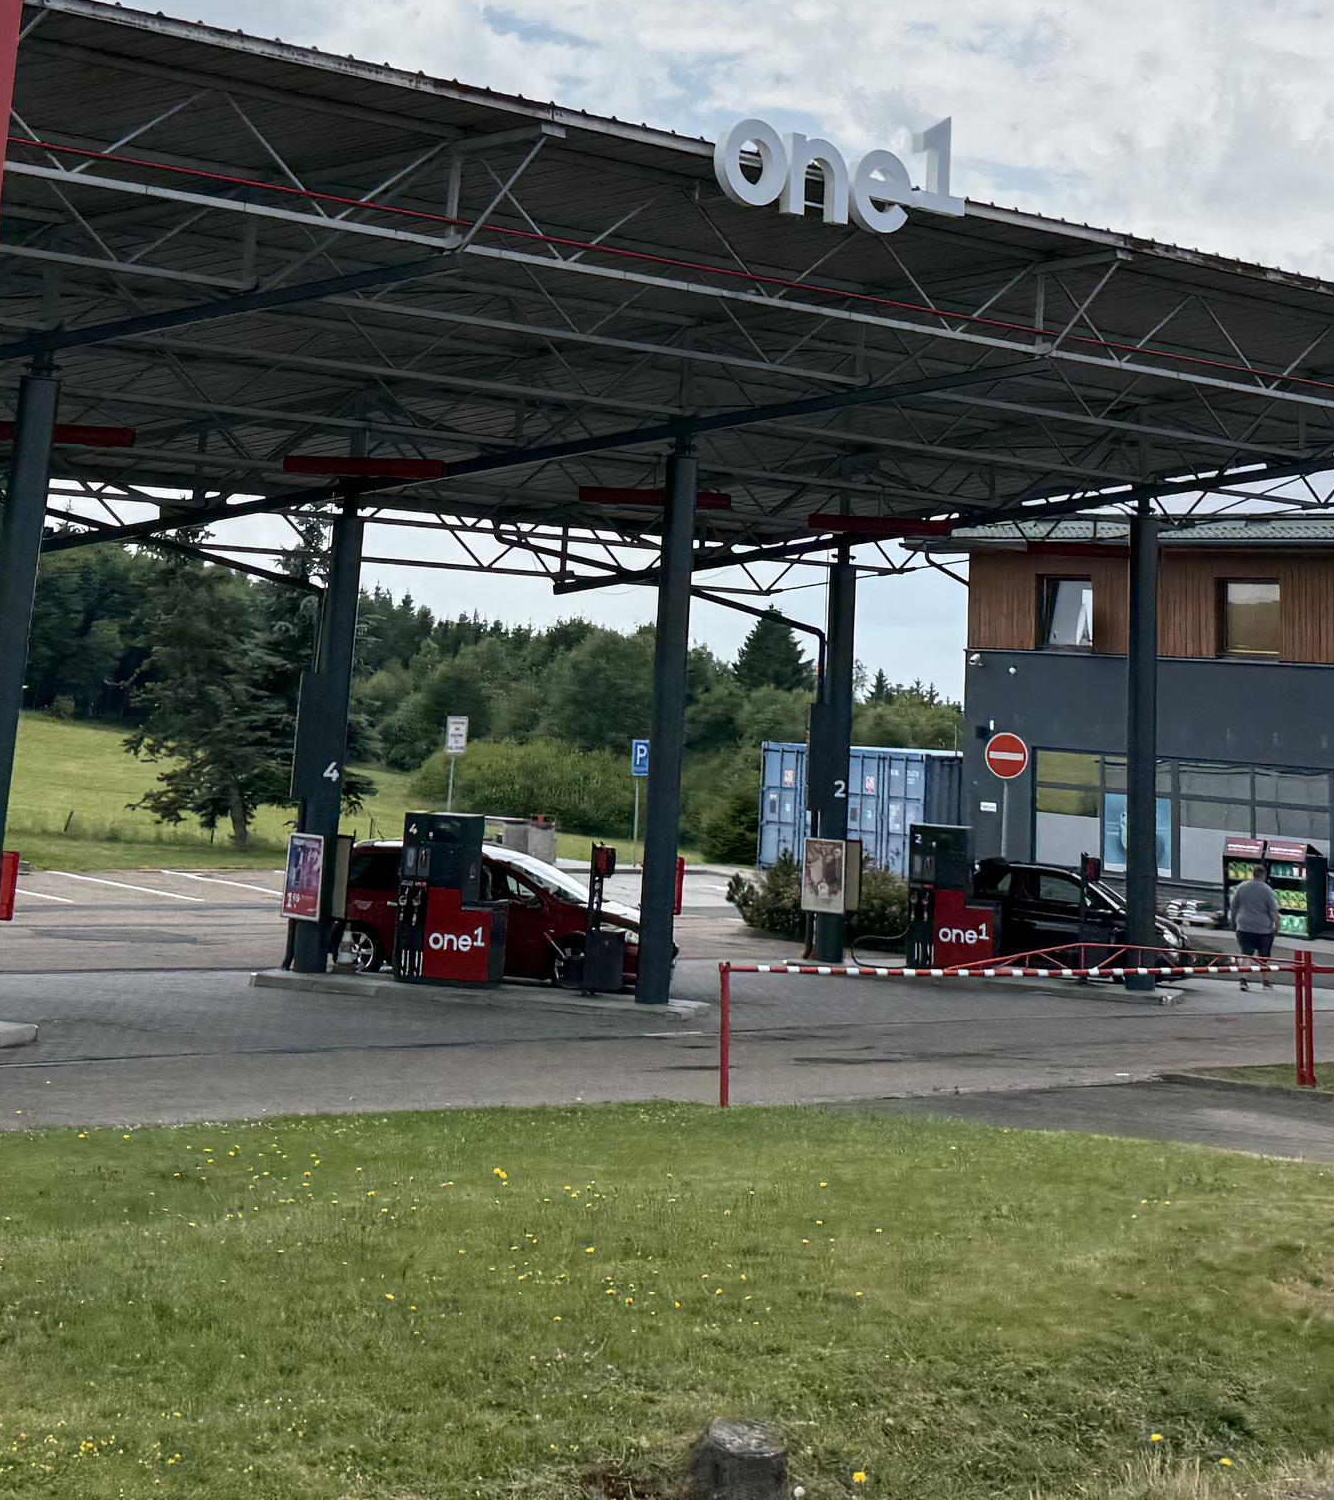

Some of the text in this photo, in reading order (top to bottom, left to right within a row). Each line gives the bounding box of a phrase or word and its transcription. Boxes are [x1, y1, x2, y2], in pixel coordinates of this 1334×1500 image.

[636, 744, 648, 765] P
[323, 761, 339, 781] 4
[834, 780, 846, 797] 2
